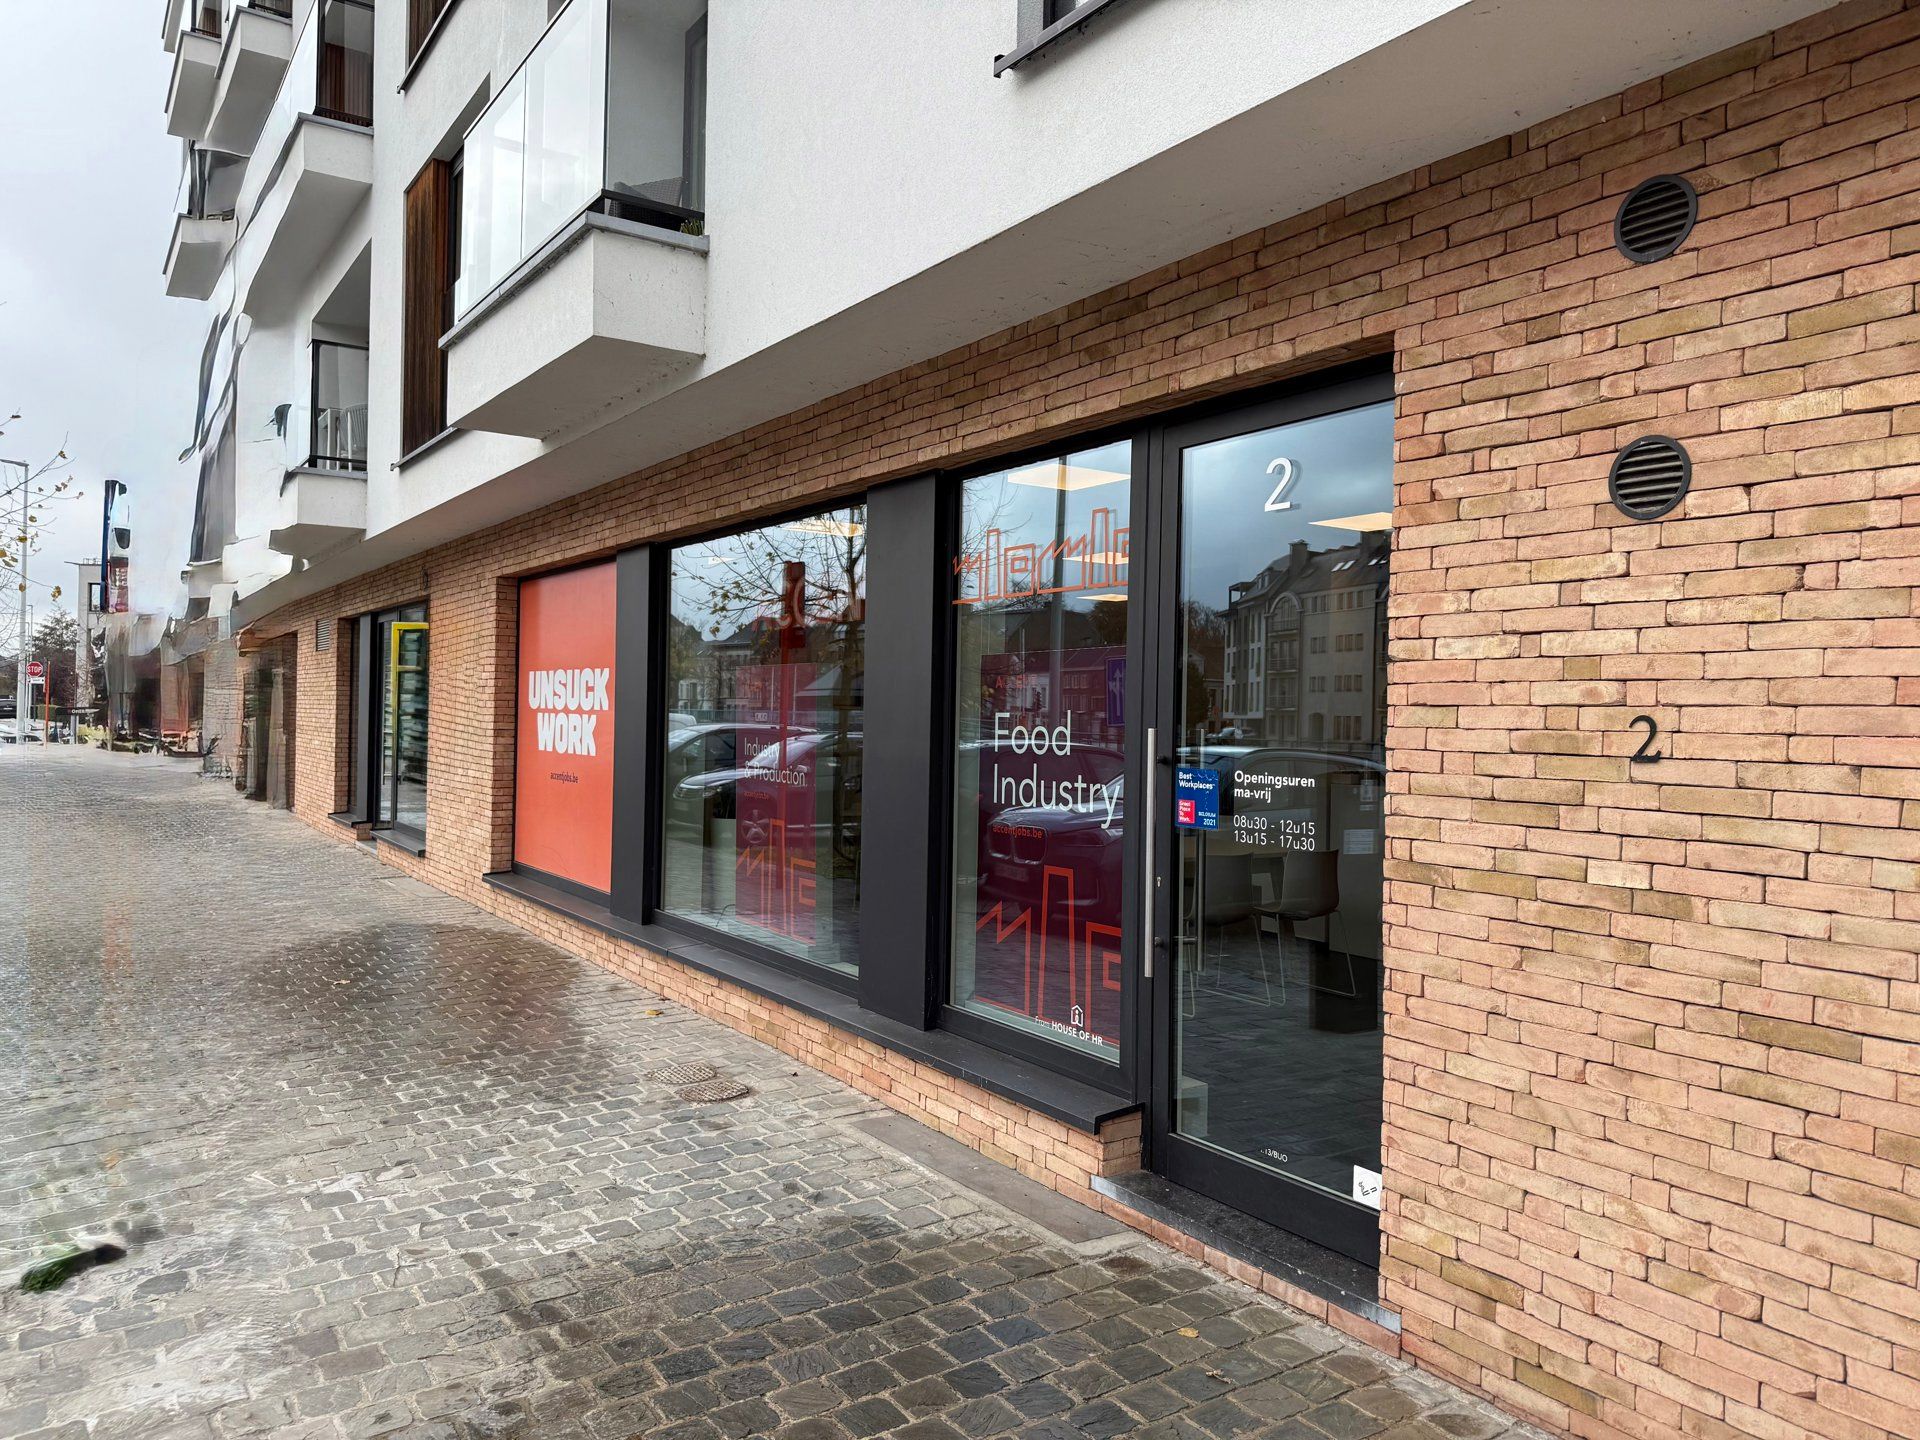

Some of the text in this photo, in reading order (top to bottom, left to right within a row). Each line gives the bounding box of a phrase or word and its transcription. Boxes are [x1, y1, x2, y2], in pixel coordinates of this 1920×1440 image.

[1264, 457, 1292, 512] 2
[528, 668, 610, 711] UNSUCK
[537, 712, 597, 756] WORK
[994, 709, 1072, 756] Food
[1628, 715, 1661, 763] 2
[744, 737, 780, 764] Industry
[550, 771, 579, 784] accentjobs.be
[754, 761, 806, 785] Production
[1178, 771, 1193, 780] Best
[1234, 770, 1316, 789] Openingsuren
[993, 763, 1121, 829] Industry
[1234, 787, 1272, 803] ma-vrij
[992, 824, 1043, 838] accentjobs.be
[1203, 818, 1216, 826] 2021
[1233, 815, 1267, 830] 08u30
[1279, 819, 1315, 836] 12u15
[1234, 830, 1267, 846] 13u15
[1279, 835, 1315, 852] 17u30
[1051, 1020, 1077, 1037] HOUSE
[1078, 1030, 1090, 1041] OF
[1091, 1034, 1103, 1046] HR
